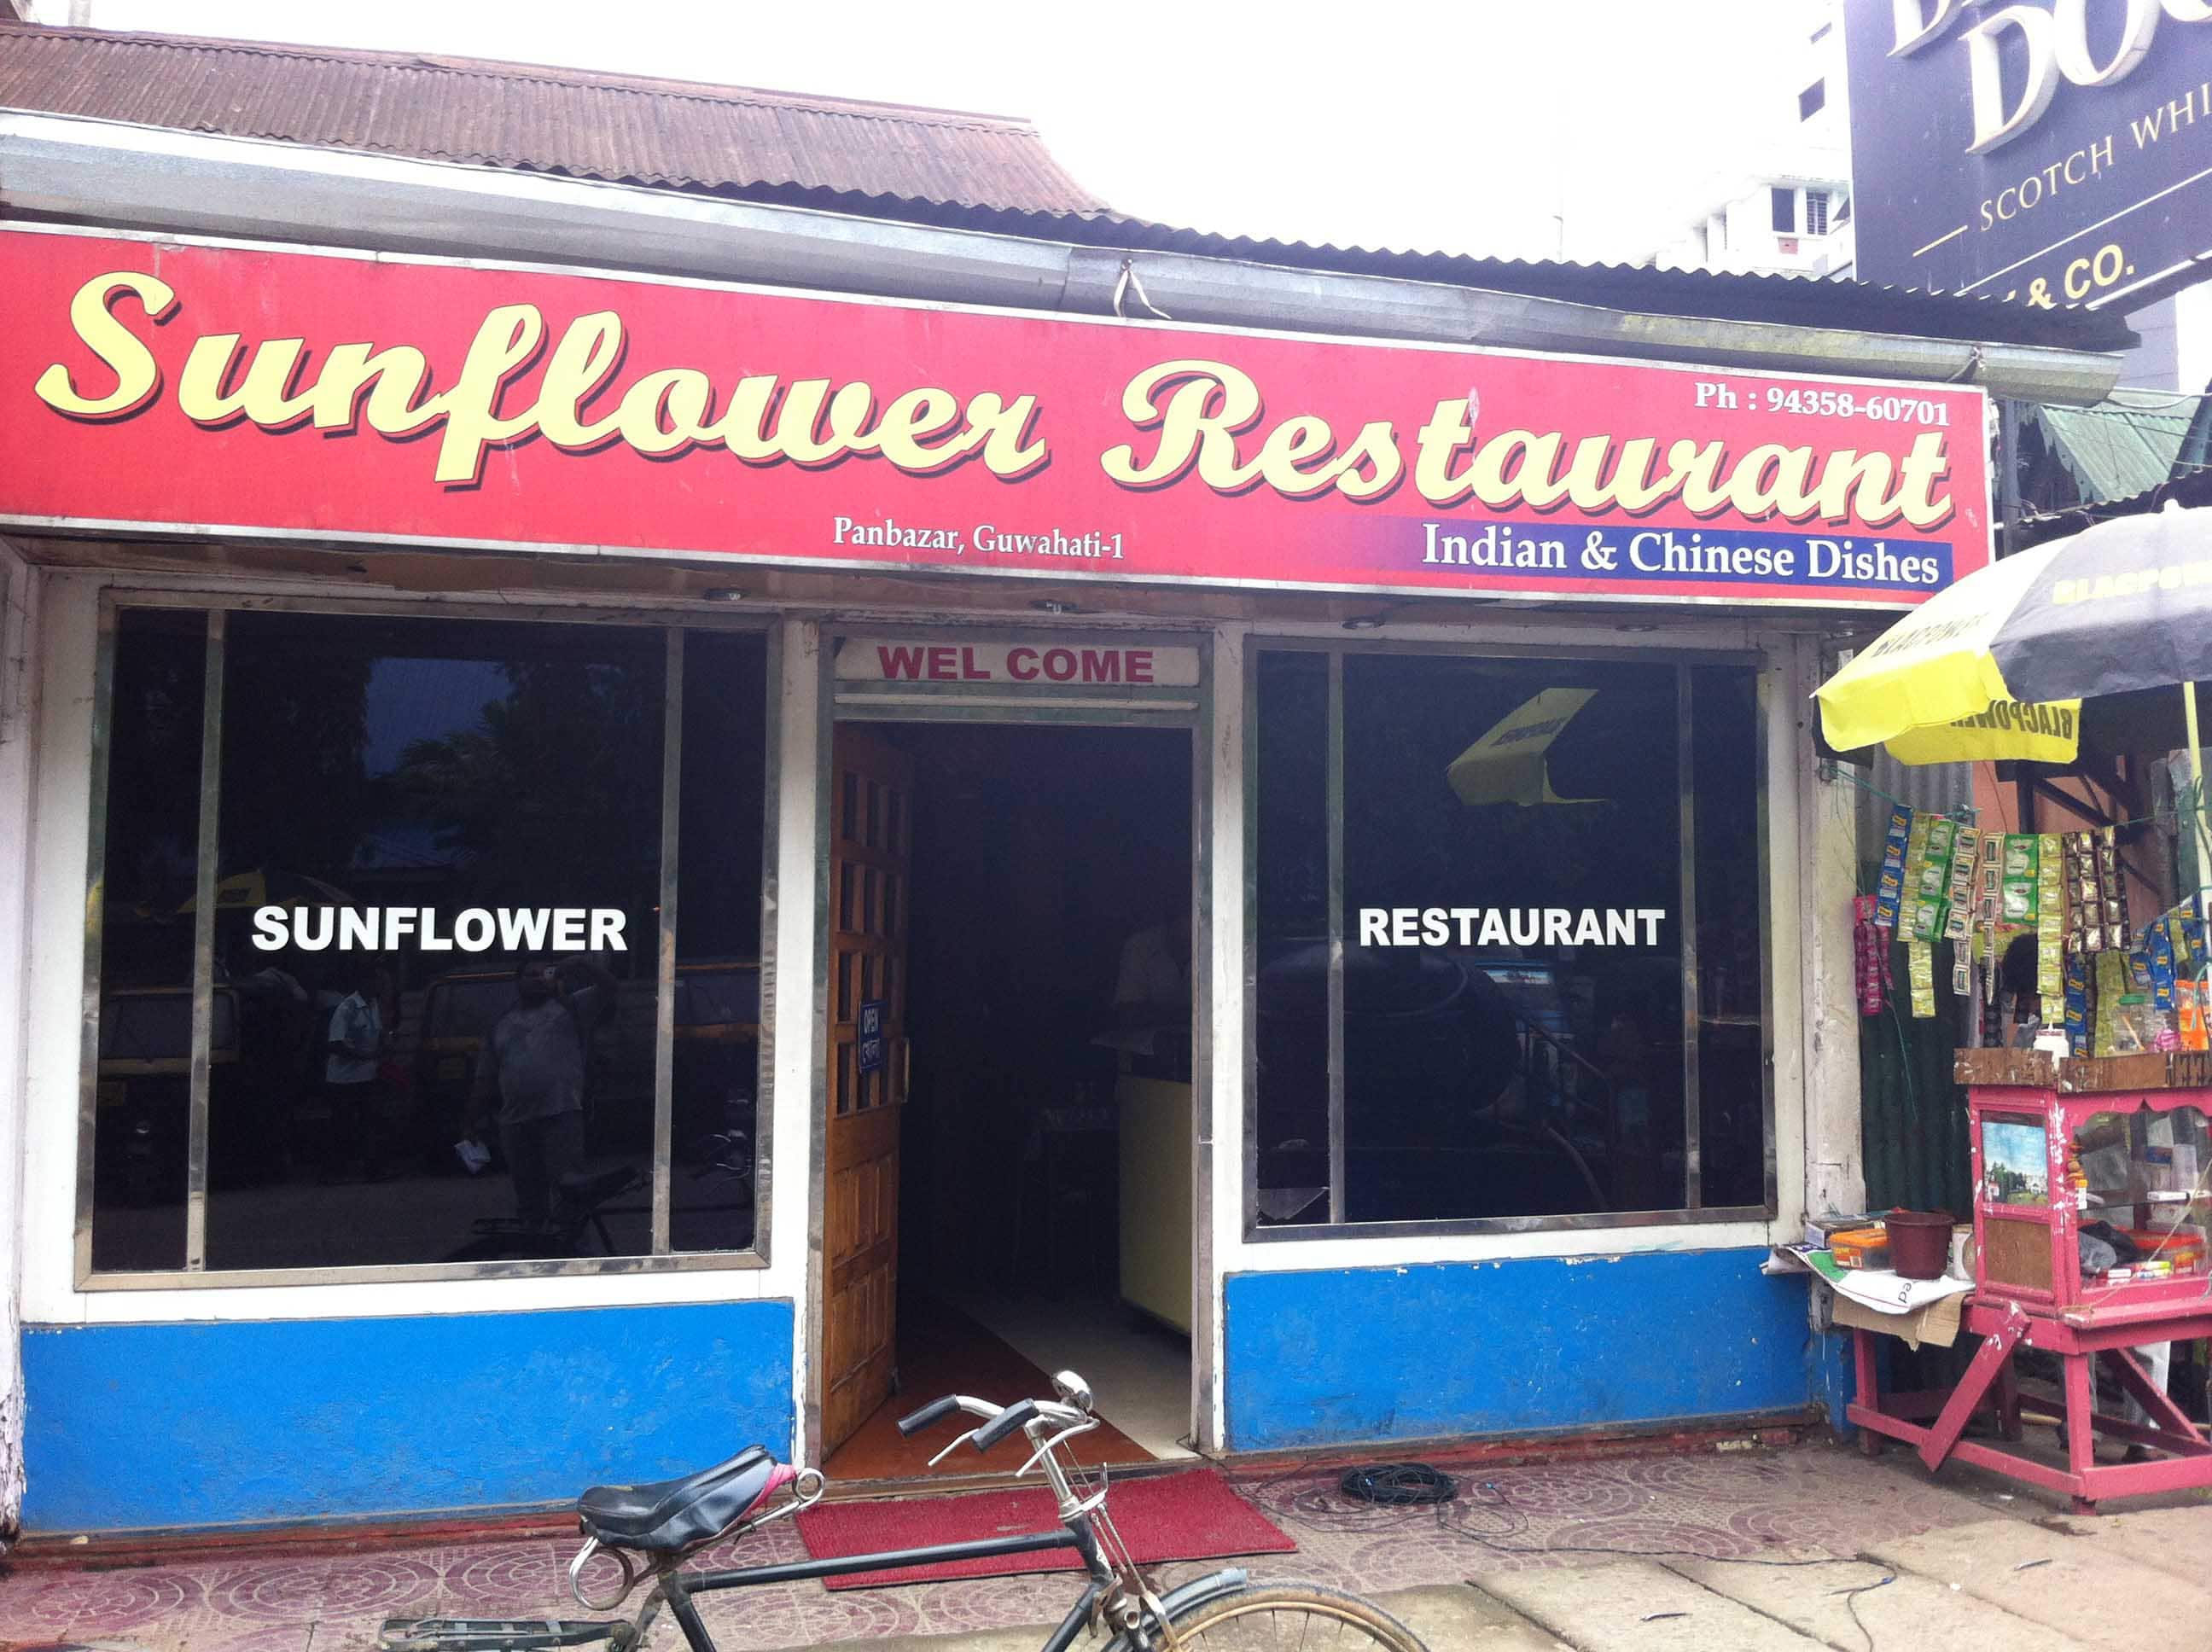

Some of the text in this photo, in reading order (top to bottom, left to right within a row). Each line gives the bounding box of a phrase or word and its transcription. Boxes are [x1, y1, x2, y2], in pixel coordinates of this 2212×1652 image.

[1958, 0, 2212, 155] DO
[1979, 82, 2212, 232] SCOTCH WHI
[2064, 244, 2134, 299] CO.
[34, 270, 1953, 528] Sunflower Restaurant
[1694, 381, 1738, 410] Ph
[1766, 387, 1950, 427] 94358-60701
[833, 515, 1125, 559] Panbazar, Guwahati-1
[1422, 523, 1940, 584] Indian & Chinese Dishes
[876, 645, 1155, 683] WEL COME
[252, 905, 629, 952] SUNFLOWER
[1359, 907, 1666, 946] RESTAURANT
